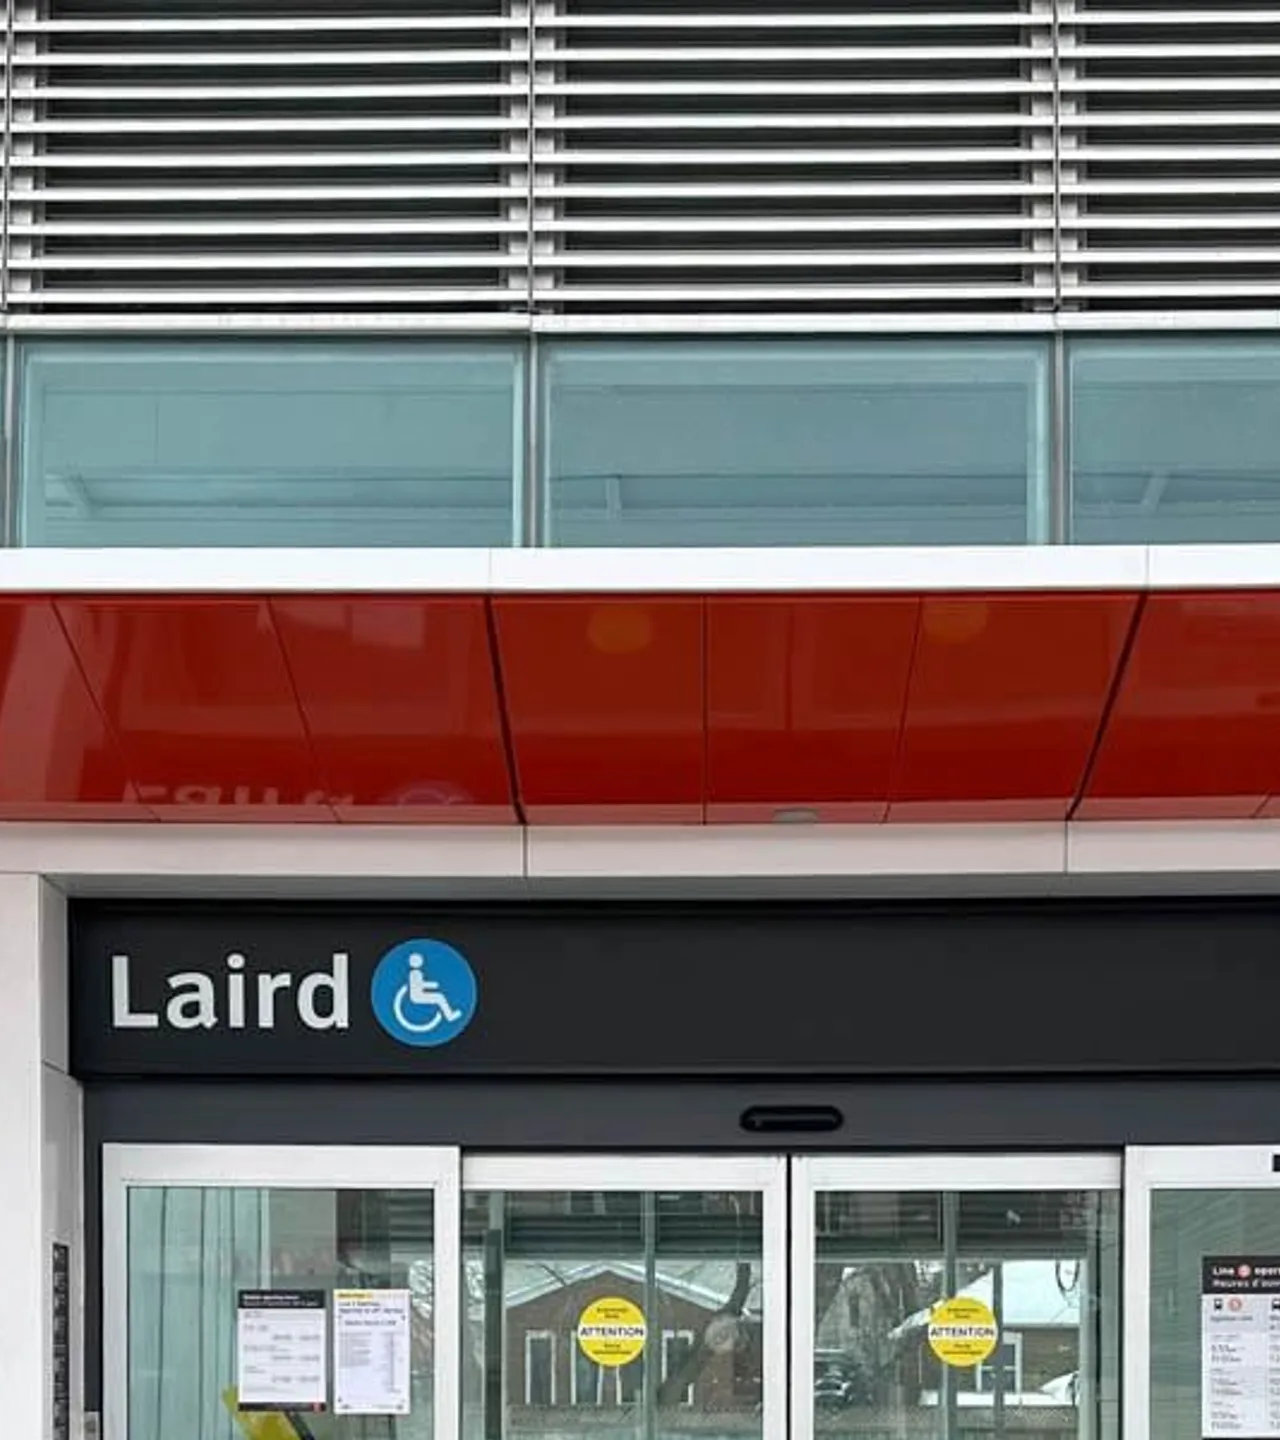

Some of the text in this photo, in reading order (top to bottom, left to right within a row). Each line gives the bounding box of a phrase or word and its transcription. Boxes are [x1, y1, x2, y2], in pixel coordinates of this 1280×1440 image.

[112, 952, 349, 1029] Laird
[580, 1327, 644, 1337] ATTENTION
[930, 1327, 995, 1337] ATTENTION
